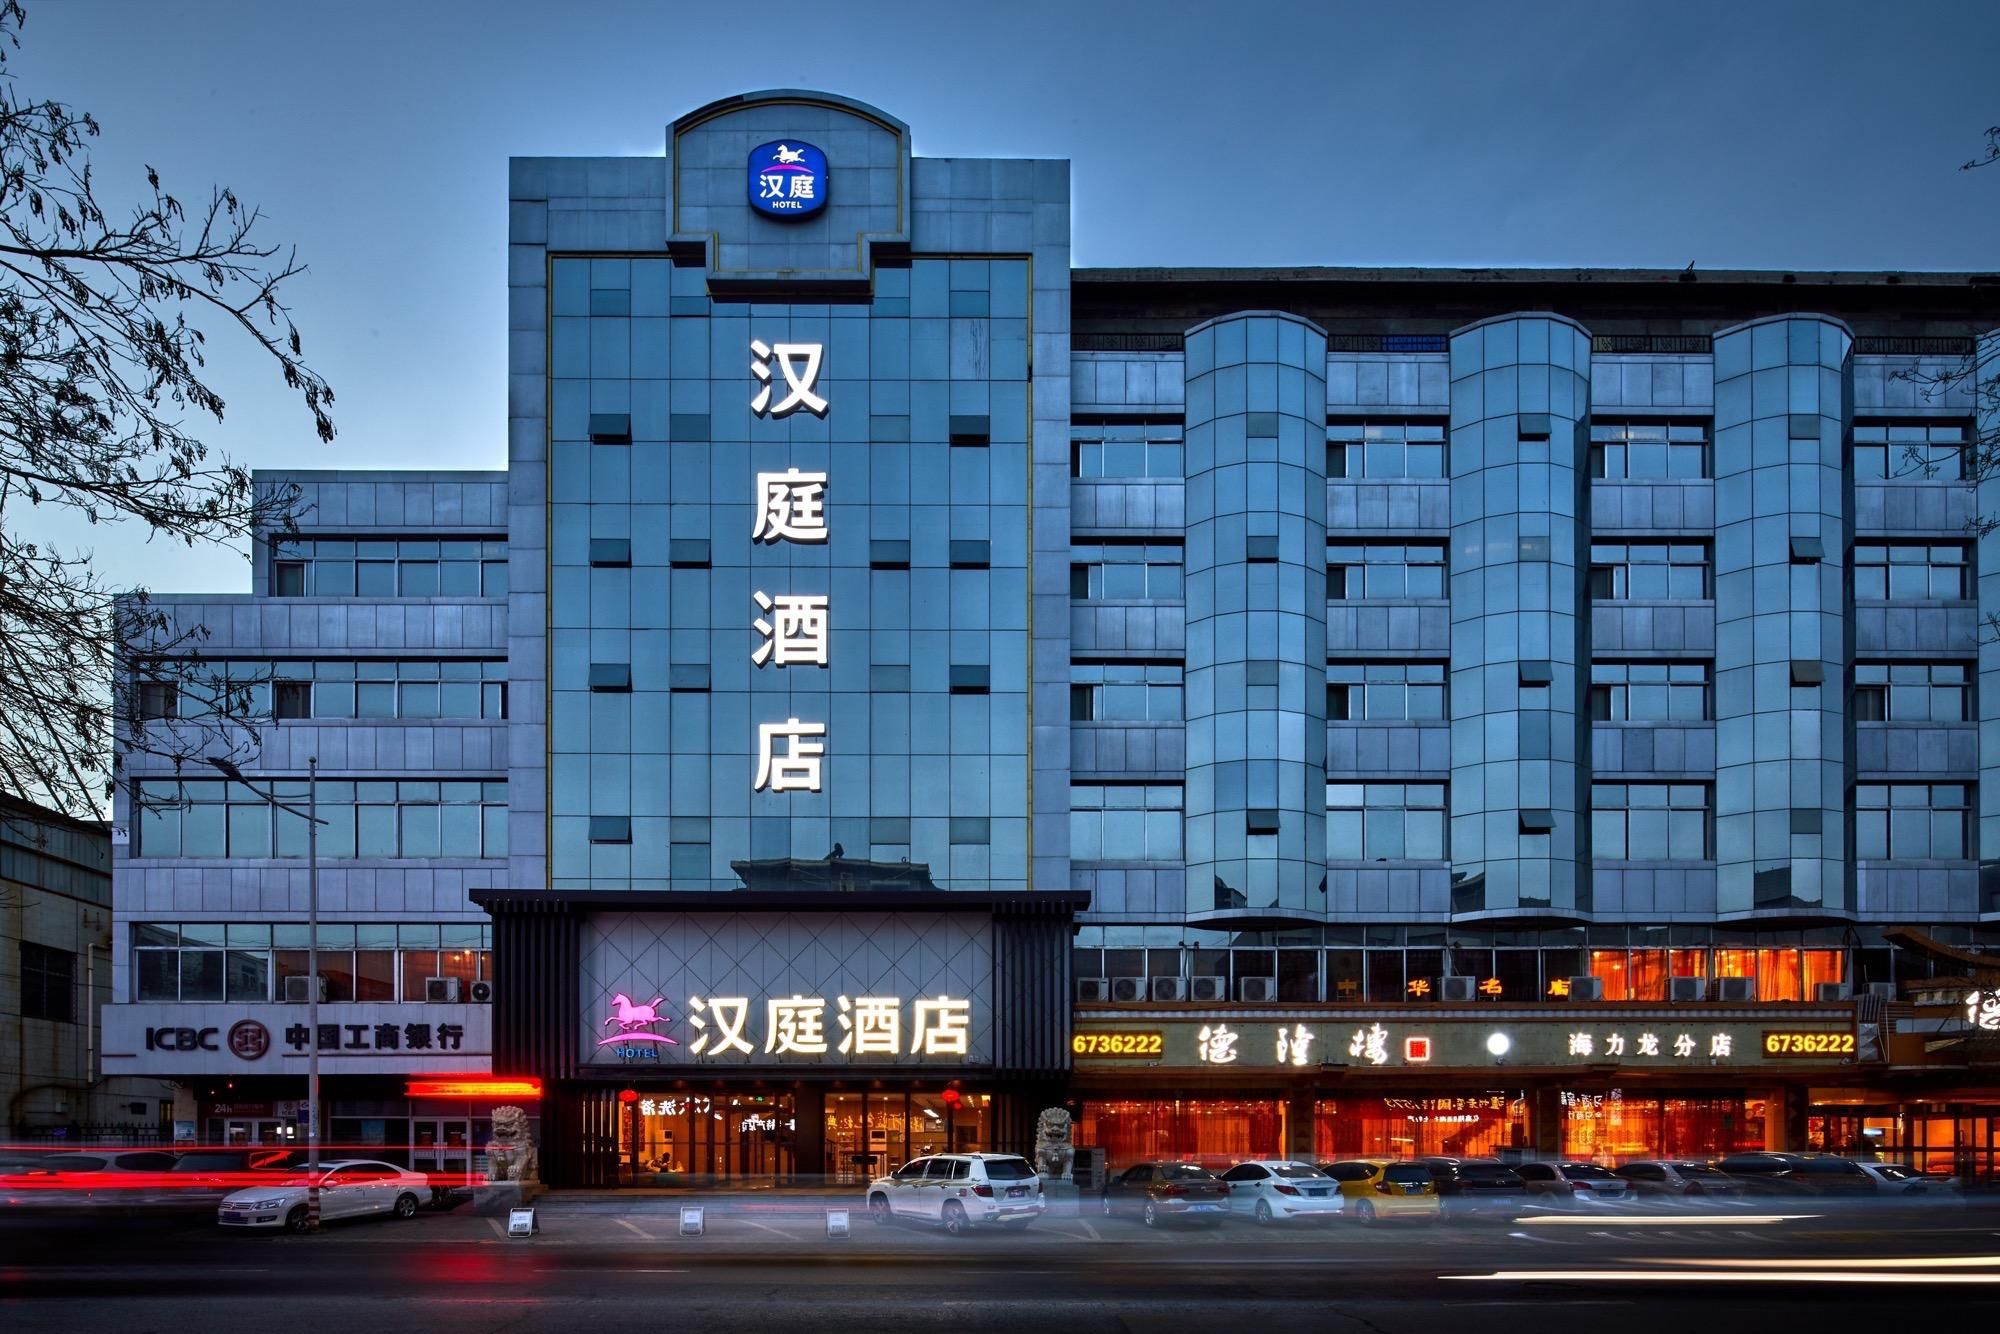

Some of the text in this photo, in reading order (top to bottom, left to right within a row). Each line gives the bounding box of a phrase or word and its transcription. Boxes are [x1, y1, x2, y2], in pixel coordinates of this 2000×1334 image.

[759, 174, 815, 199] 汉庭
[772, 201, 803, 209] HOTEL
[751, 339, 830, 792] 汉庭酒店
[689, 995, 971, 1056] 汉庭酒店
[145, 1027, 219, 1051] ICBC
[1073, 1034, 1163, 1054] 6736222
[1569, 1033, 1733, 1057] 海力龙分店
[1766, 1033, 1855, 1054] 6736222
[616, 1047, 658, 1059] HOTEL
